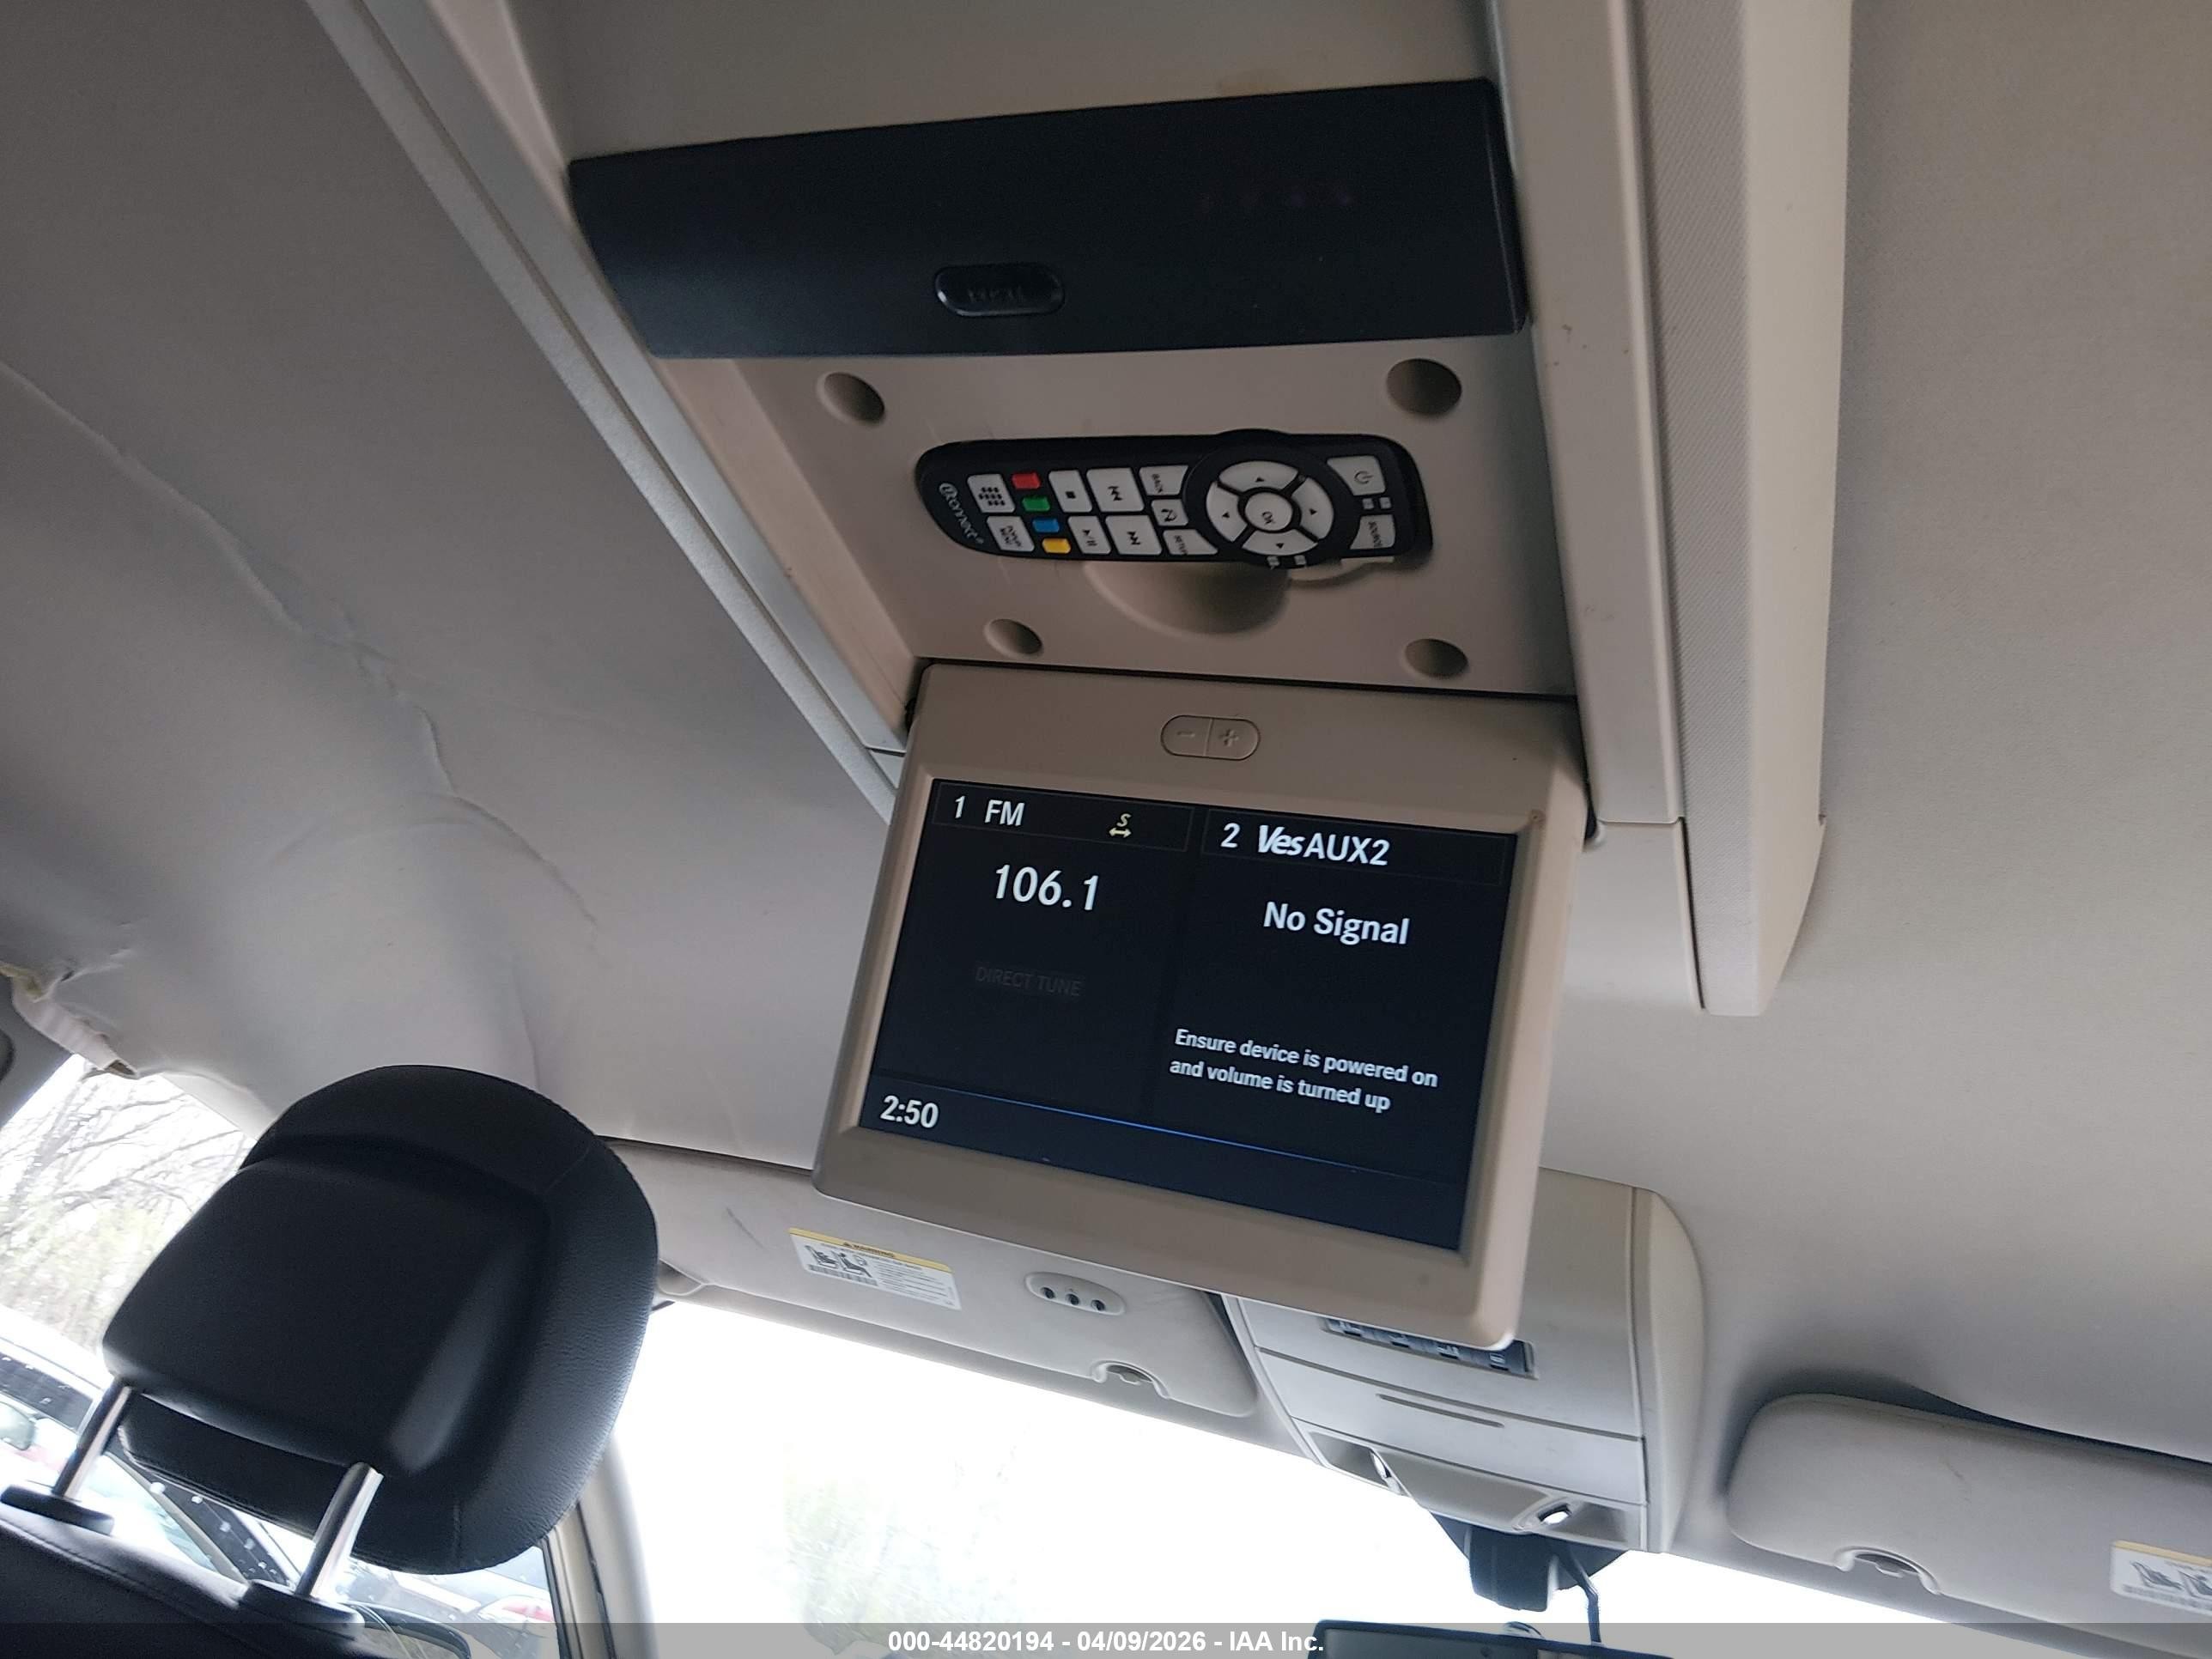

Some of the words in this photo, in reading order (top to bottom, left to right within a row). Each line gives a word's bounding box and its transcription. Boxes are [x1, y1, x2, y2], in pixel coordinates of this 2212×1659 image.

[1261, 511, 1275, 526] OK
[955, 795, 965, 818] 1
[984, 799, 1025, 827] FM
[1220, 822, 1241, 848] 2
[995, 864, 1099, 911] 106.1
[1263, 901, 1306, 932] No
[1313, 908, 1410, 945] Signal
[975, 966, 1036, 990] DIRECT
[1037, 975, 1082, 997] TUNE
[1175, 1028, 1237, 1054] Ensure
[1239, 1039, 1300, 1064] device
[1303, 1048, 1321, 1067] is
[1322, 1056, 1409, 1082] powered
[1411, 1071, 1438, 1087] on
[1170, 1060, 1205, 1078] and
[1206, 1066, 1273, 1090] volume
[1276, 1074, 1294, 1093] is
[1297, 1079, 1362, 1105] turned
[1364, 1094, 1391, 1114] up
[879, 1095, 939, 1128] 2:50
